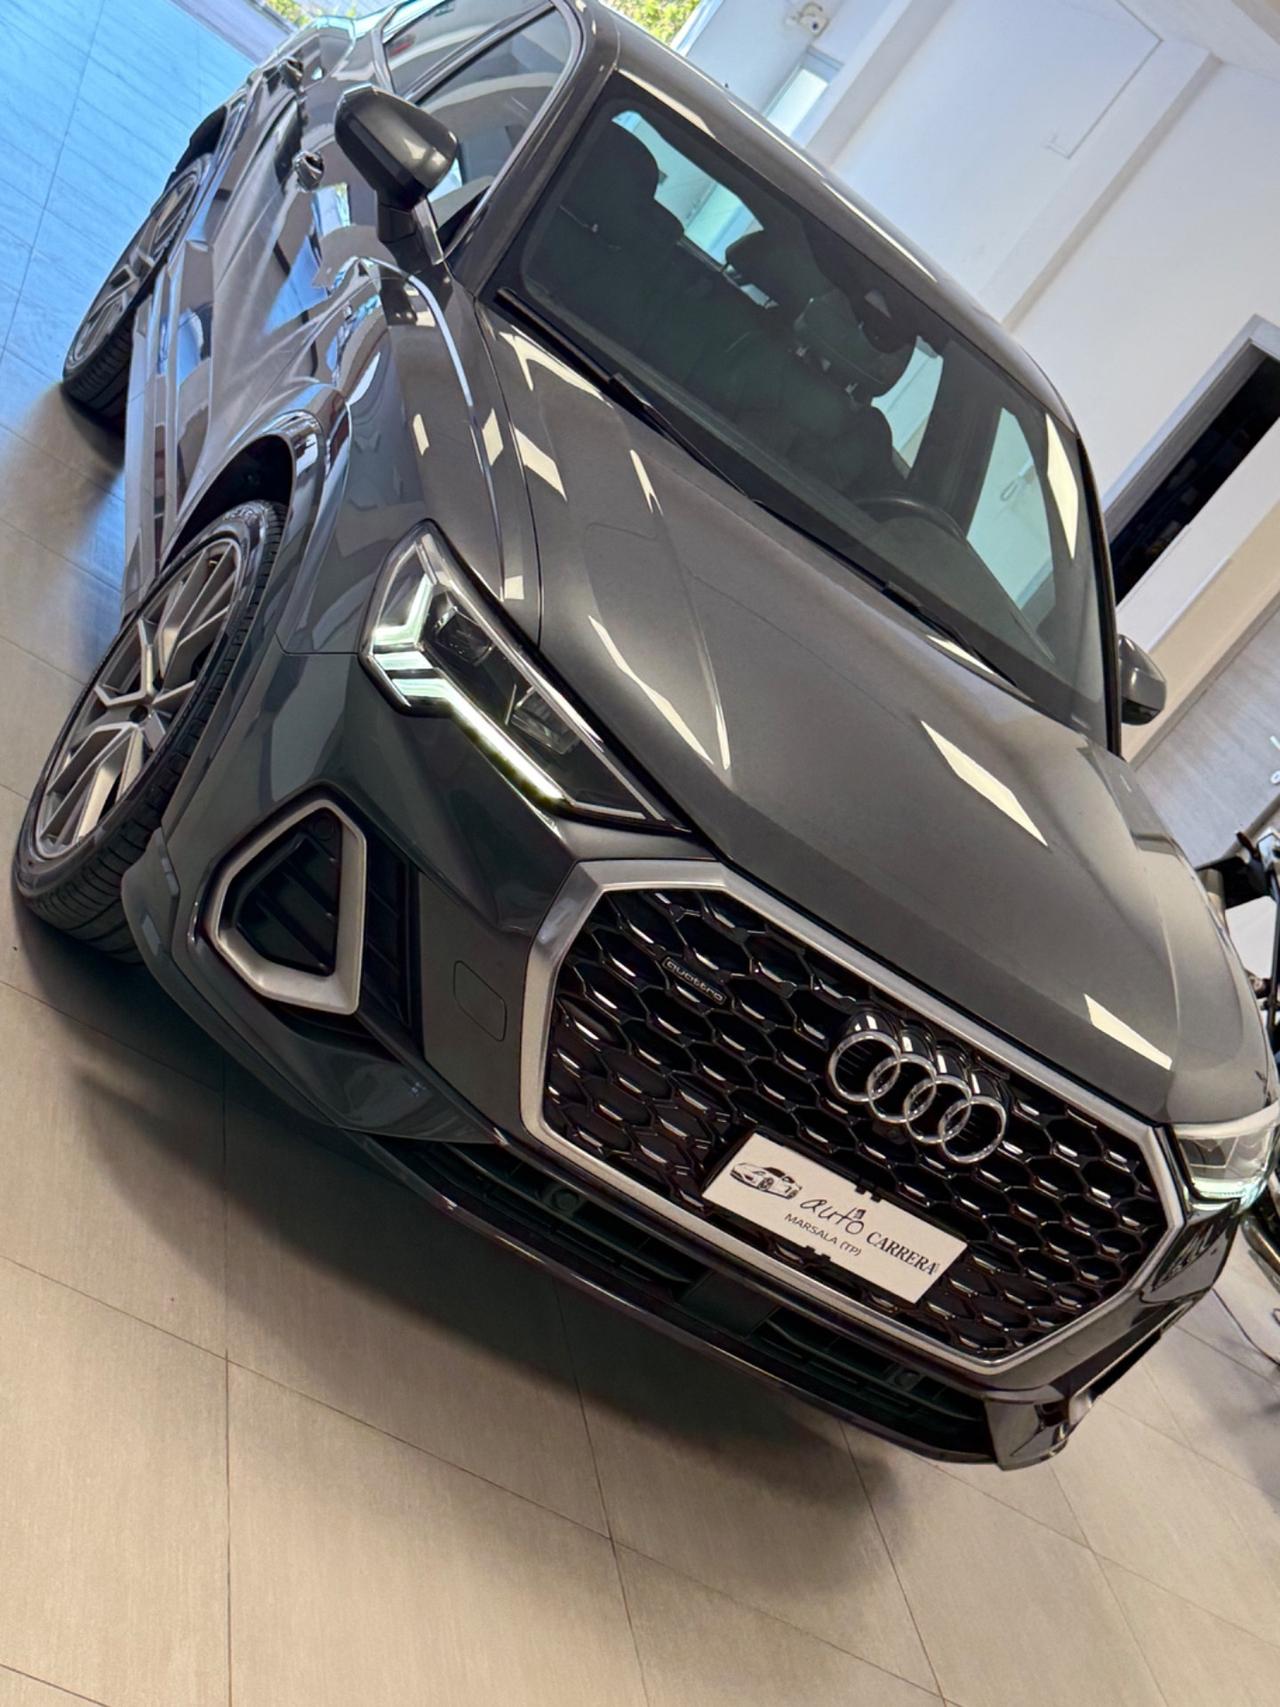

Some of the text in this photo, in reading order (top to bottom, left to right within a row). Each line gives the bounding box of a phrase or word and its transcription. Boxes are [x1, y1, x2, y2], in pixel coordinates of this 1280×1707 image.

[666, 960, 724, 1001] quattro
[784, 1213, 862, 1257] MARSALA (TP)
[866, 1231, 938, 1275] CARRERA
